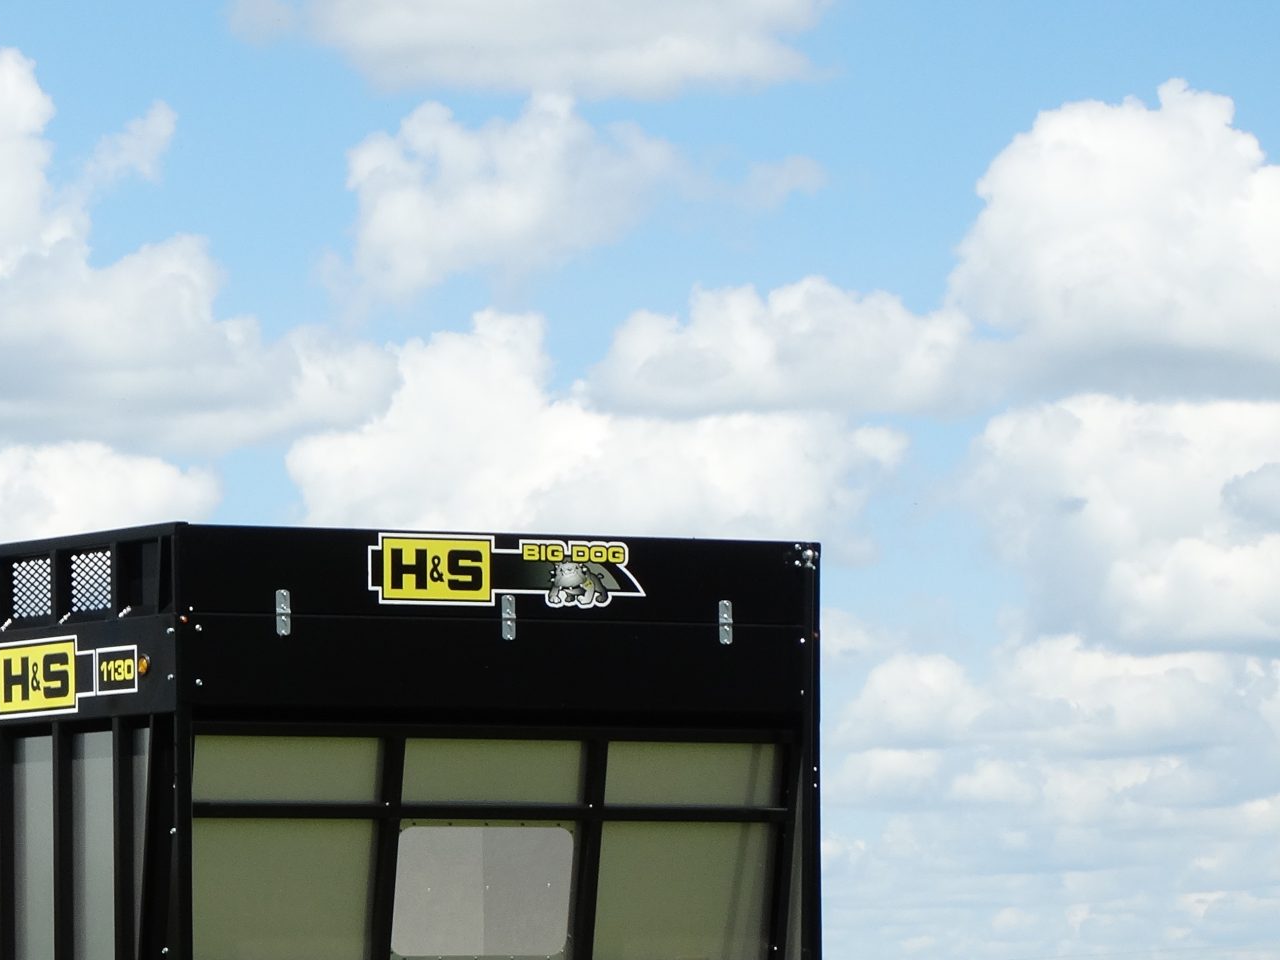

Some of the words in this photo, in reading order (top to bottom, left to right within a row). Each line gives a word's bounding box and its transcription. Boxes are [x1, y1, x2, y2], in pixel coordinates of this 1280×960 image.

[390, 547, 483, 592] H&S
[522, 543, 564, 562] BIG
[571, 544, 626, 564] DOG
[2, 652, 70, 704] H&S
[100, 658, 135, 682] 1130
